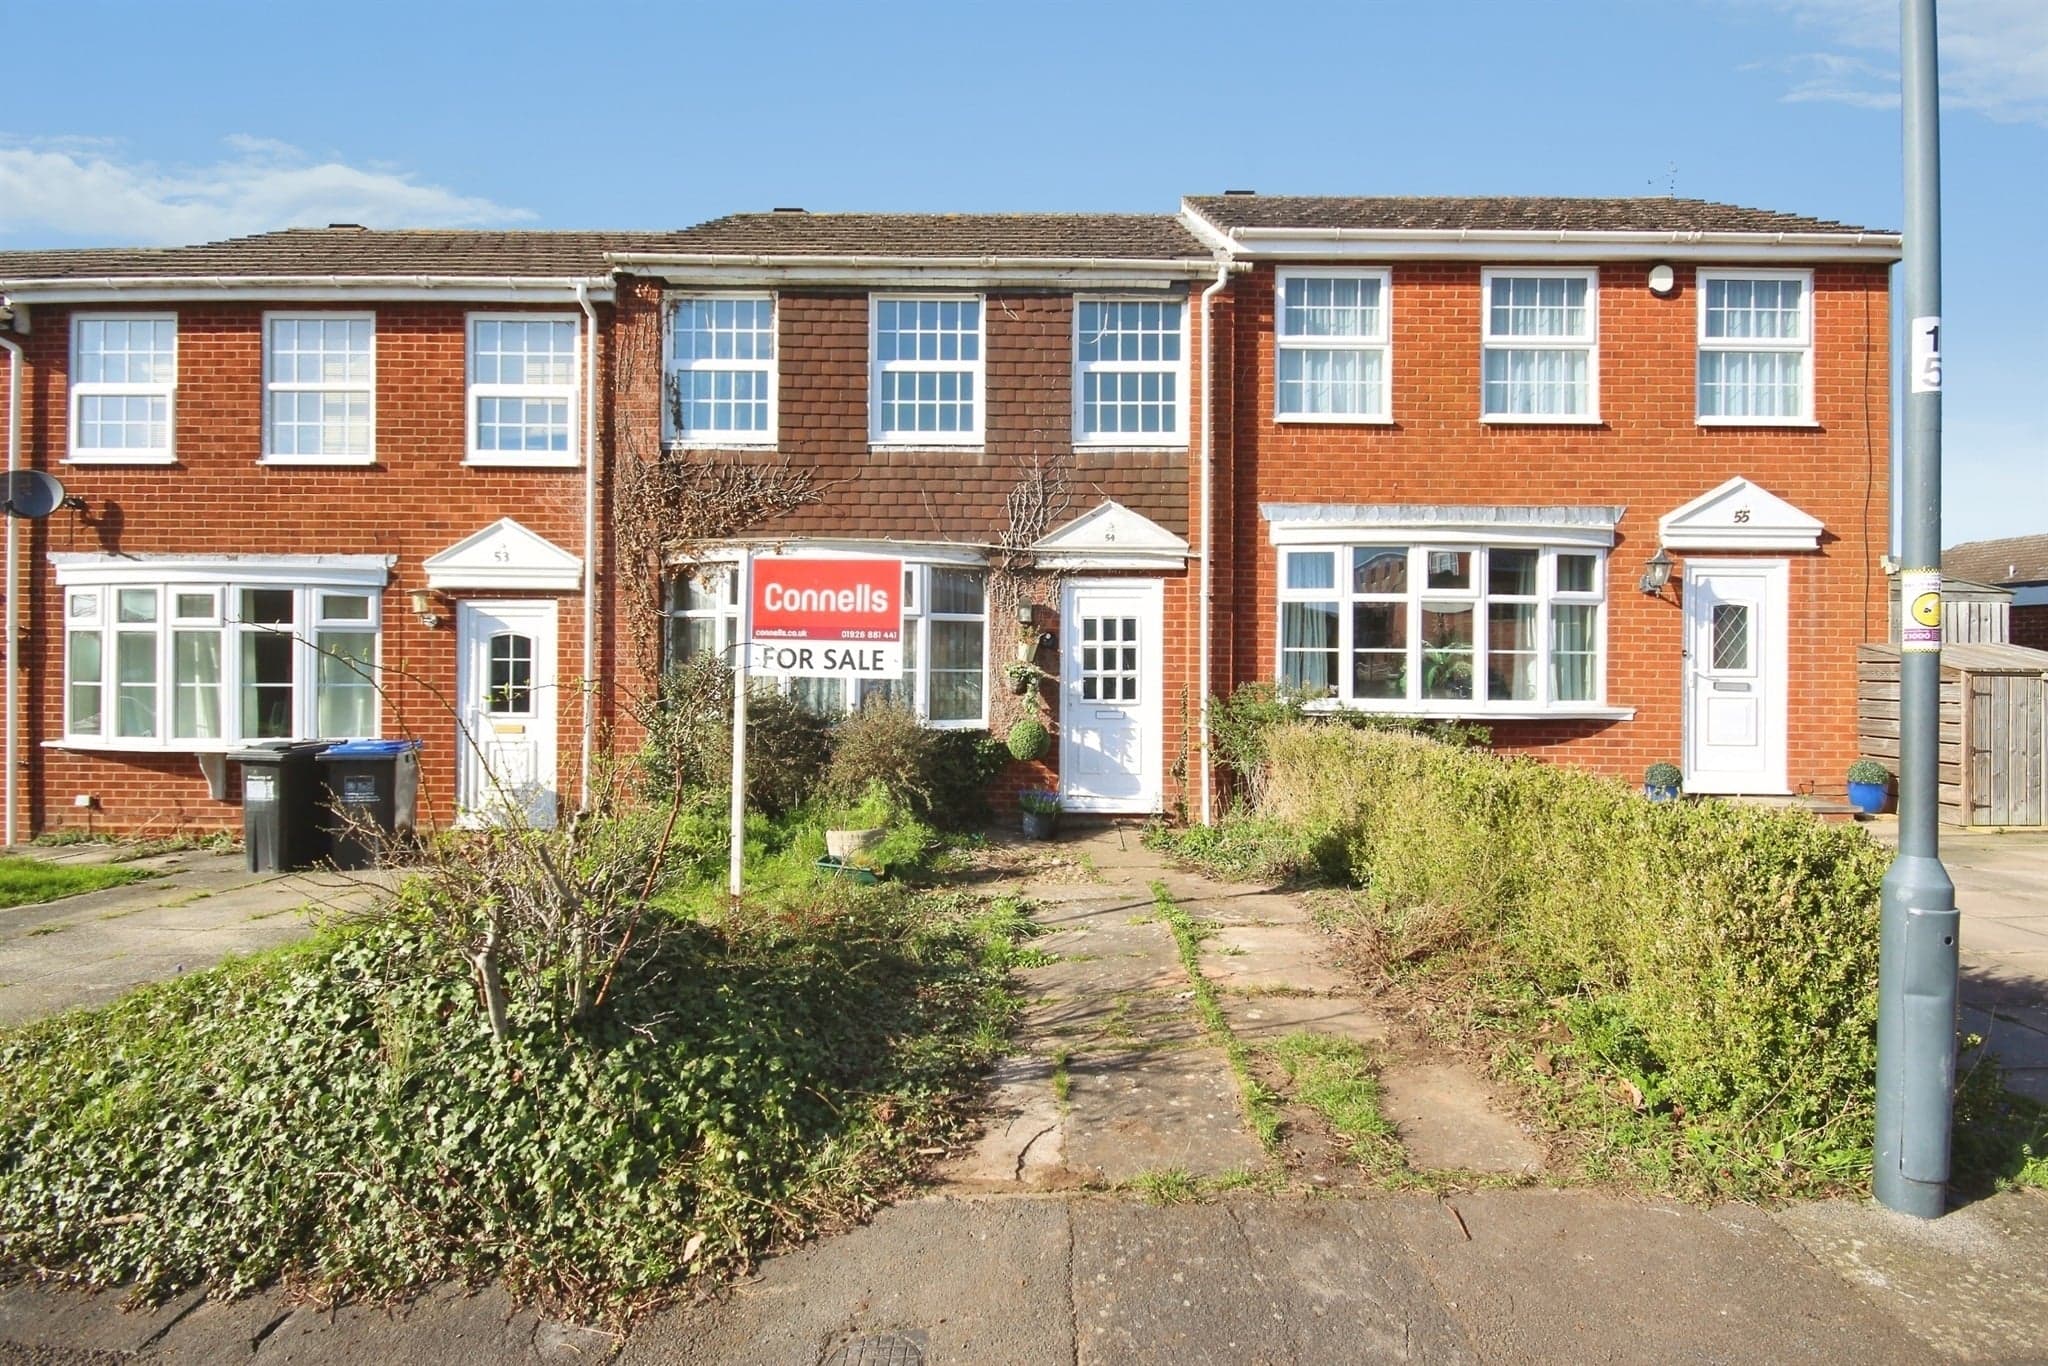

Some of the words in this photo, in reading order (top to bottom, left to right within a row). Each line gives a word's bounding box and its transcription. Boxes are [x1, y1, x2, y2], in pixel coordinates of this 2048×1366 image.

[1733, 510, 1750, 523] 55
[764, 582, 889, 614] Connells
[762, 647, 814, 669] FOR
[823, 648, 885, 671] SALE
